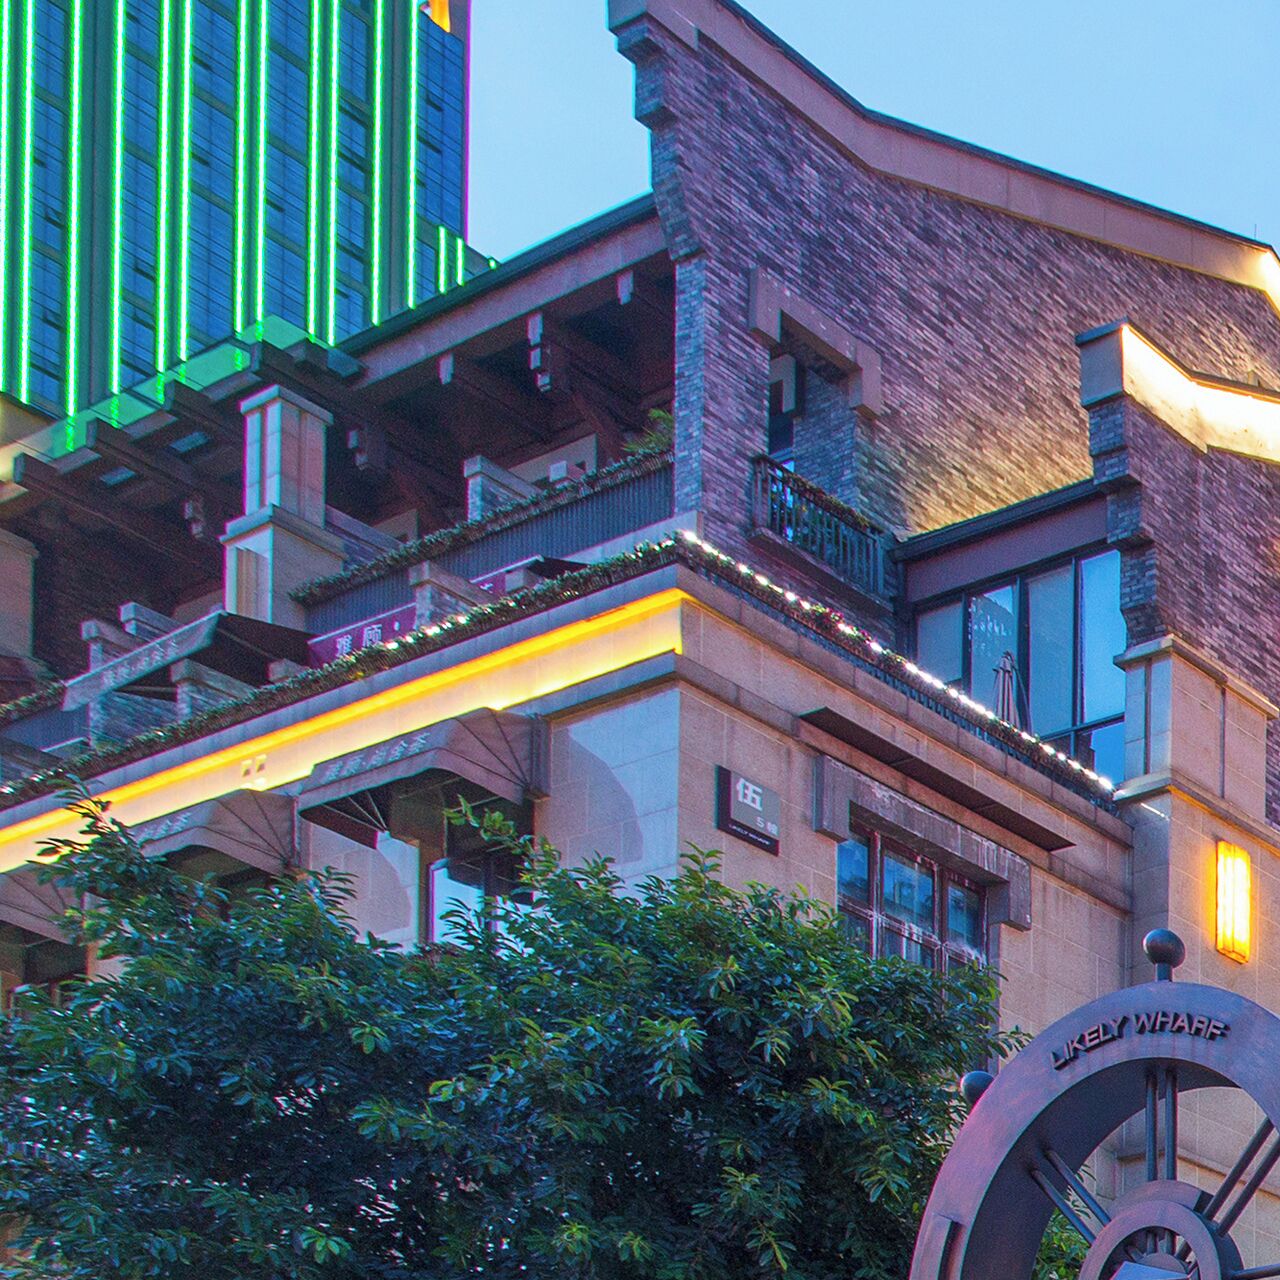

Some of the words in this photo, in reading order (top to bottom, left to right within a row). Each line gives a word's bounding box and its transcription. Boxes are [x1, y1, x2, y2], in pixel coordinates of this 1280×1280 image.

[736, 778, 763, 812] 伍
[1052, 1014, 1130, 1071] LIKELY
[1134, 1011, 1231, 1041] WHARF
